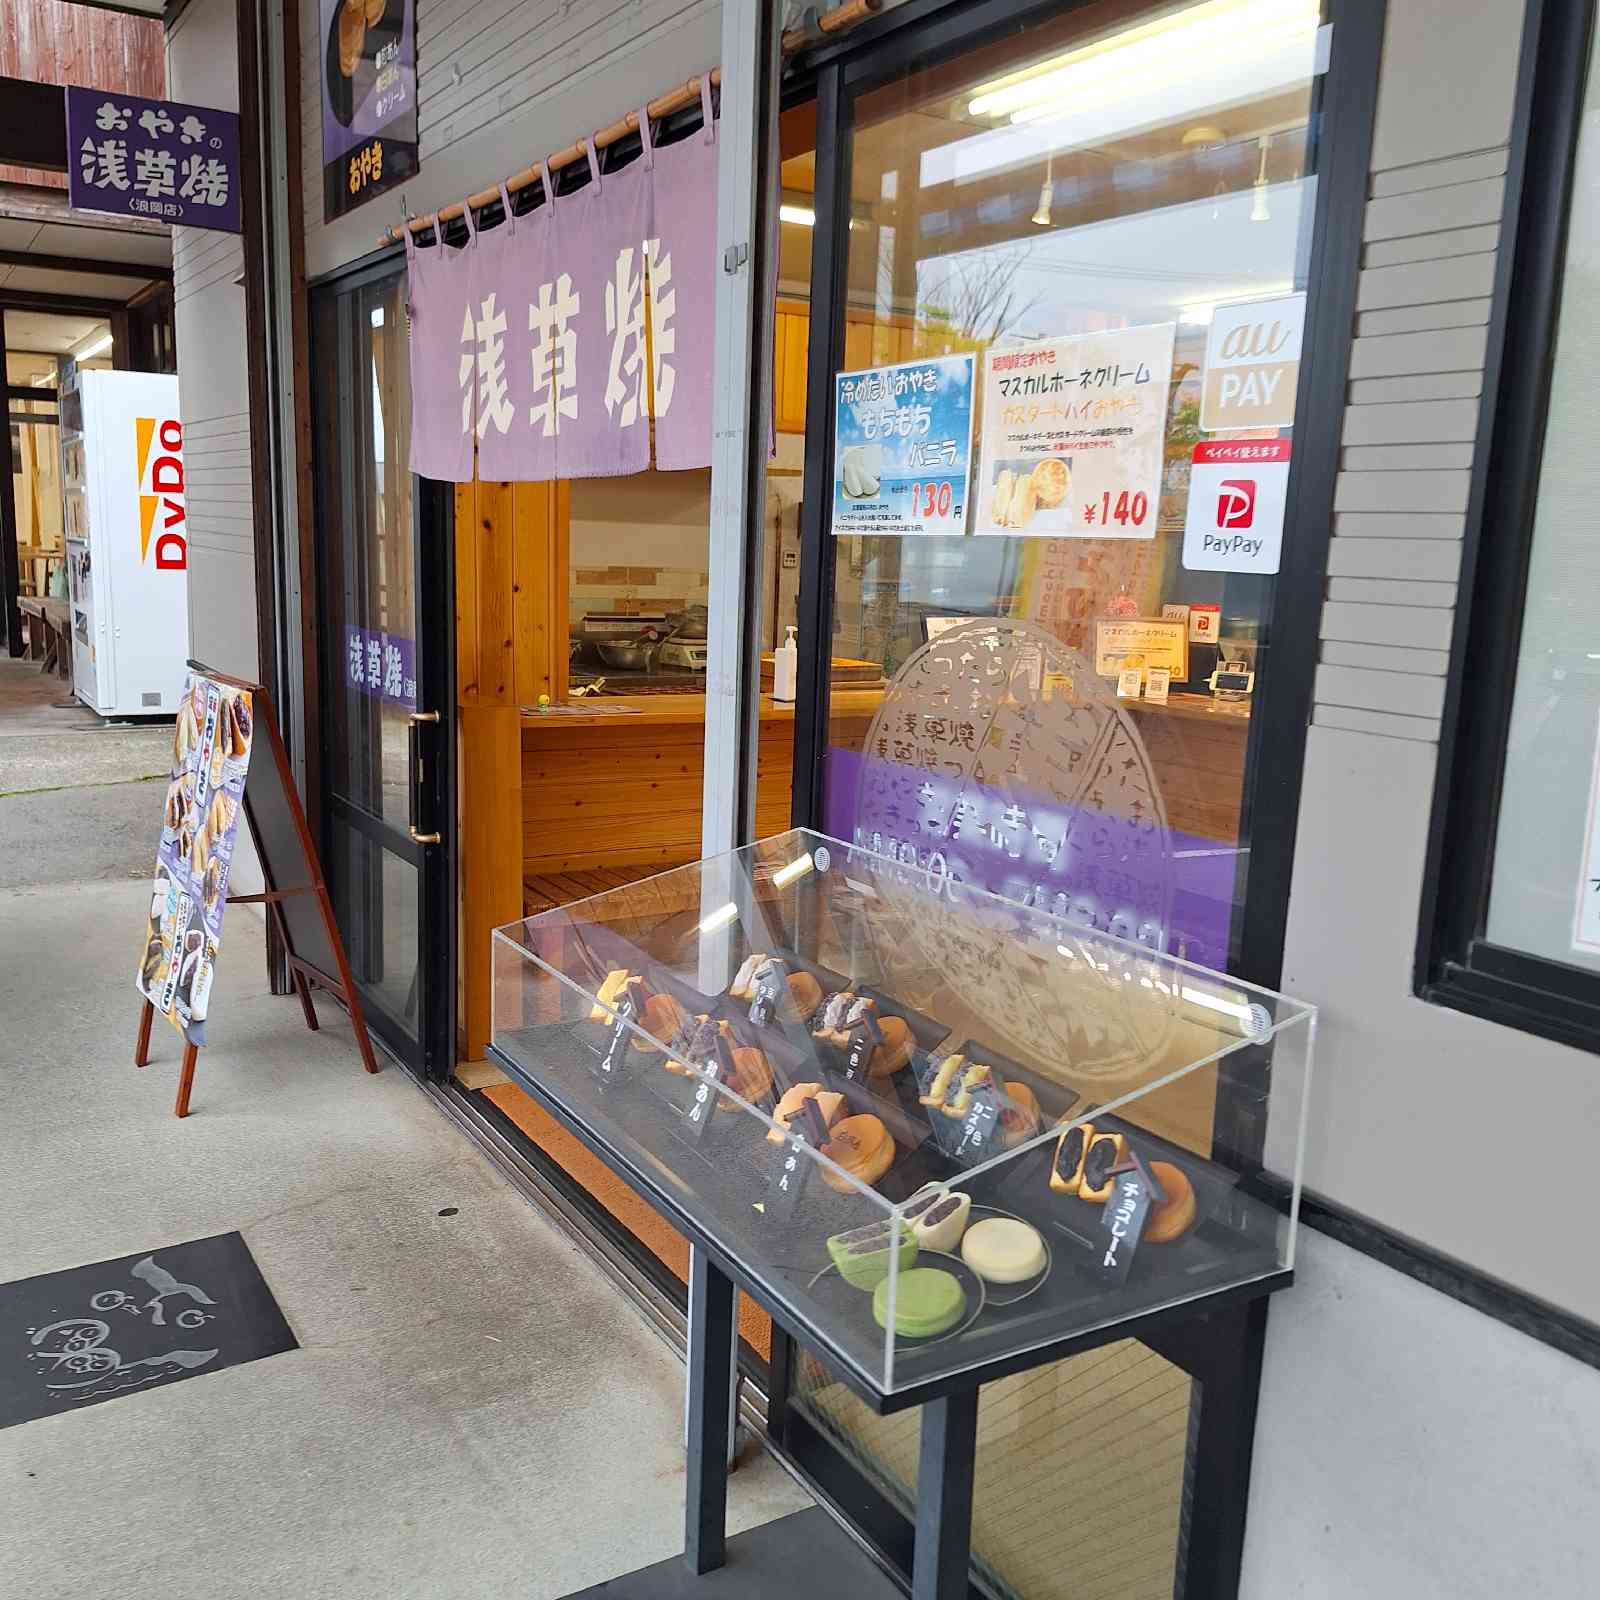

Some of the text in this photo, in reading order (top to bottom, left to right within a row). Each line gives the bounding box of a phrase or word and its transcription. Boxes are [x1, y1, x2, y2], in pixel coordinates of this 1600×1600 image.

[80, 136, 229, 207] 浅草焼
[349, 141, 383, 193] おやき
[459, 238, 676, 439] 浅草焼
[1220, 320, 1292, 360] au
[1218, 369, 1284, 408] PAY
[862, 403, 933, 440] もちもち
[910, 439, 958, 468] バニラ
[152, 419, 187, 570] DyDo
[1202, 535, 1264, 557] PayPay
[1103, 1182, 1139, 1267] チョコレート
